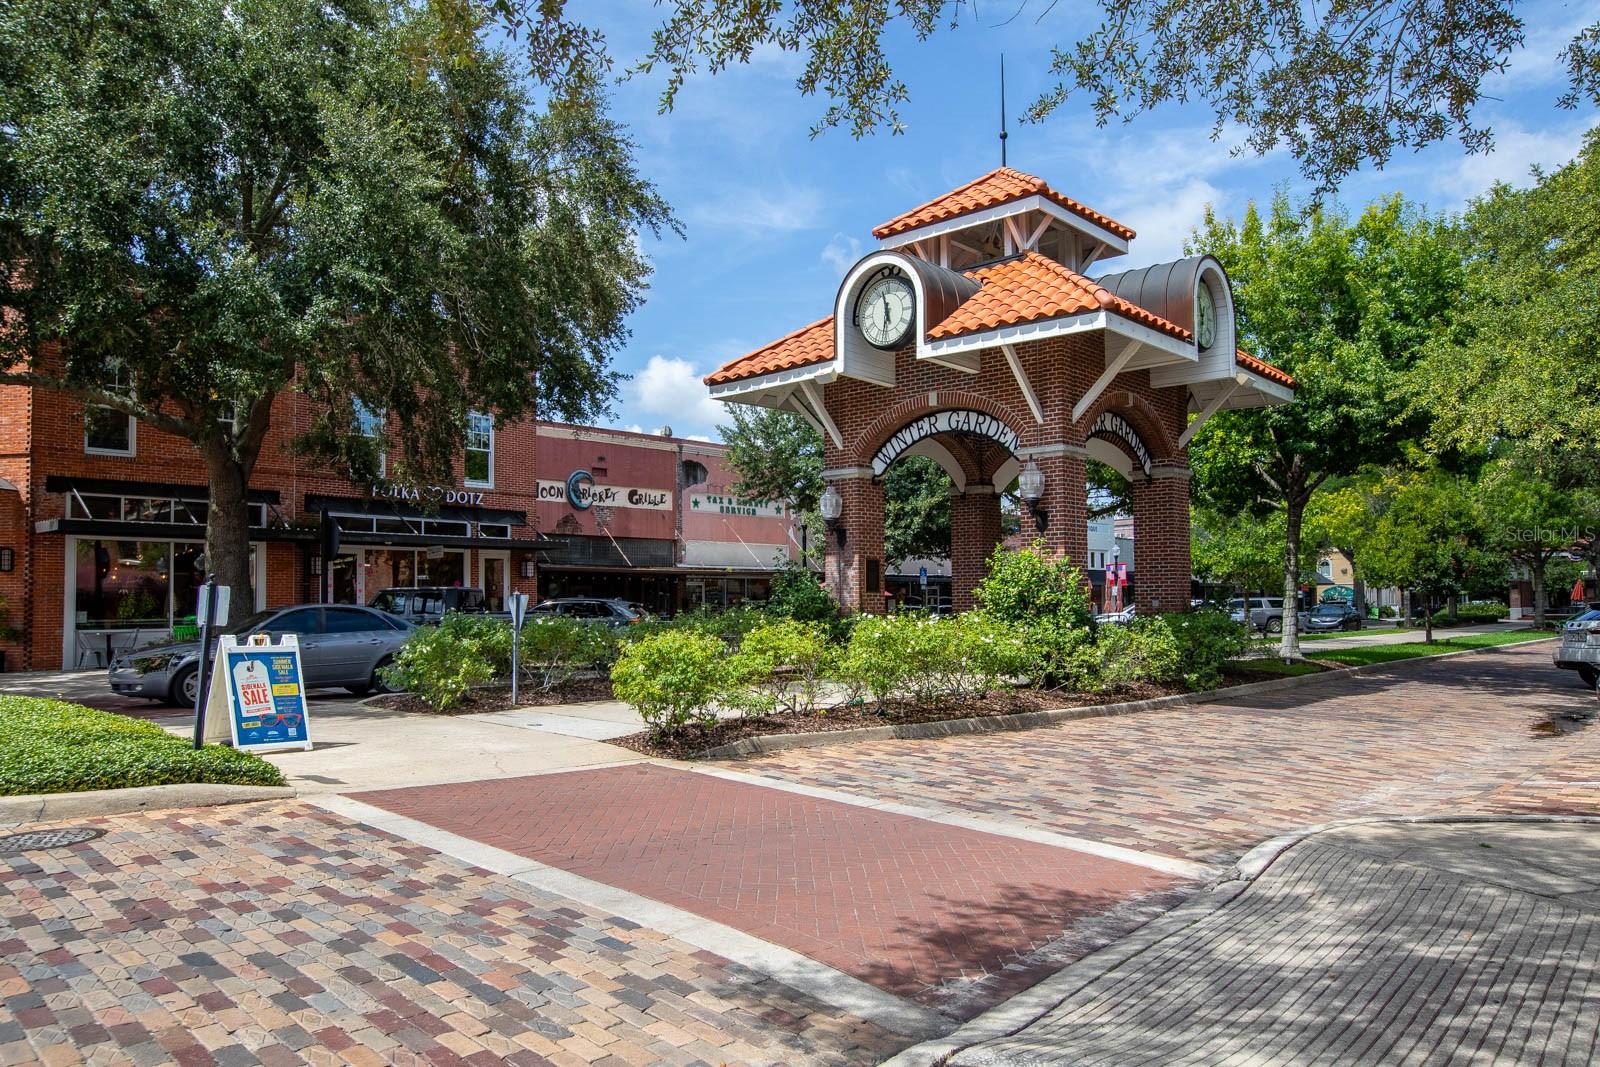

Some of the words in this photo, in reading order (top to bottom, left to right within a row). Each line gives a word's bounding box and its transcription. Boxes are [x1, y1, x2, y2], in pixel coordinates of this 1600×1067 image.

[876, 415, 941, 466] WINTER
[948, 411, 1020, 454] GARDEN
[446, 490, 484, 505] DOTZ
[706, 495, 724, 505] TAX
[720, 506, 757, 516] SERVICE
[241, 682, 267, 691] SIDEWALK
[242, 689, 270, 706] SALE
